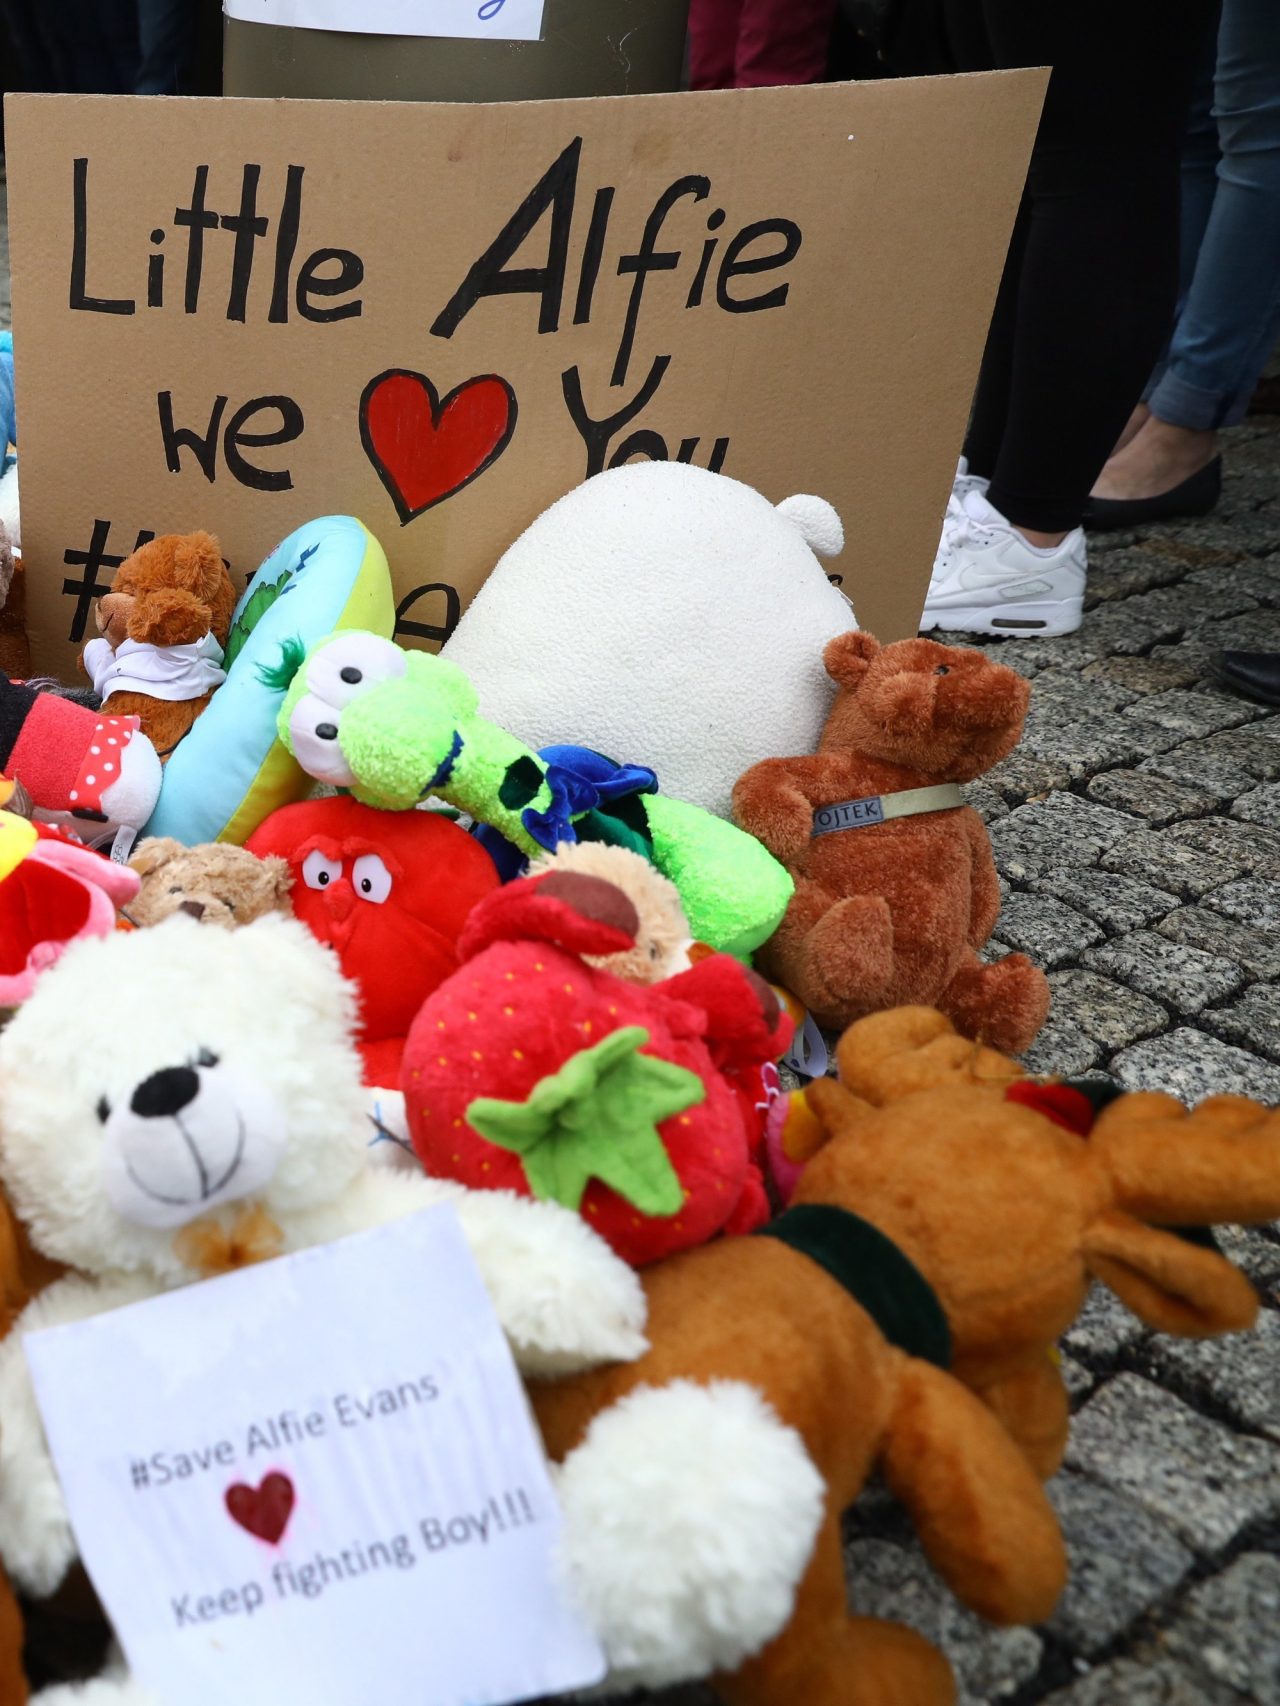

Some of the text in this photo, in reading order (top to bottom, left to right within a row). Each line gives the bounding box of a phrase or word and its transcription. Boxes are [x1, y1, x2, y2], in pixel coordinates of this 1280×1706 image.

[69, 135, 803, 388] Little Alfie
[157, 390, 305, 492] we
[818, 801, 880, 827] OJTEK
[129, 1371, 441, 1491] #Save Alfie Evans
[170, 1488, 536, 1628] Keep fighting Boy!!!
